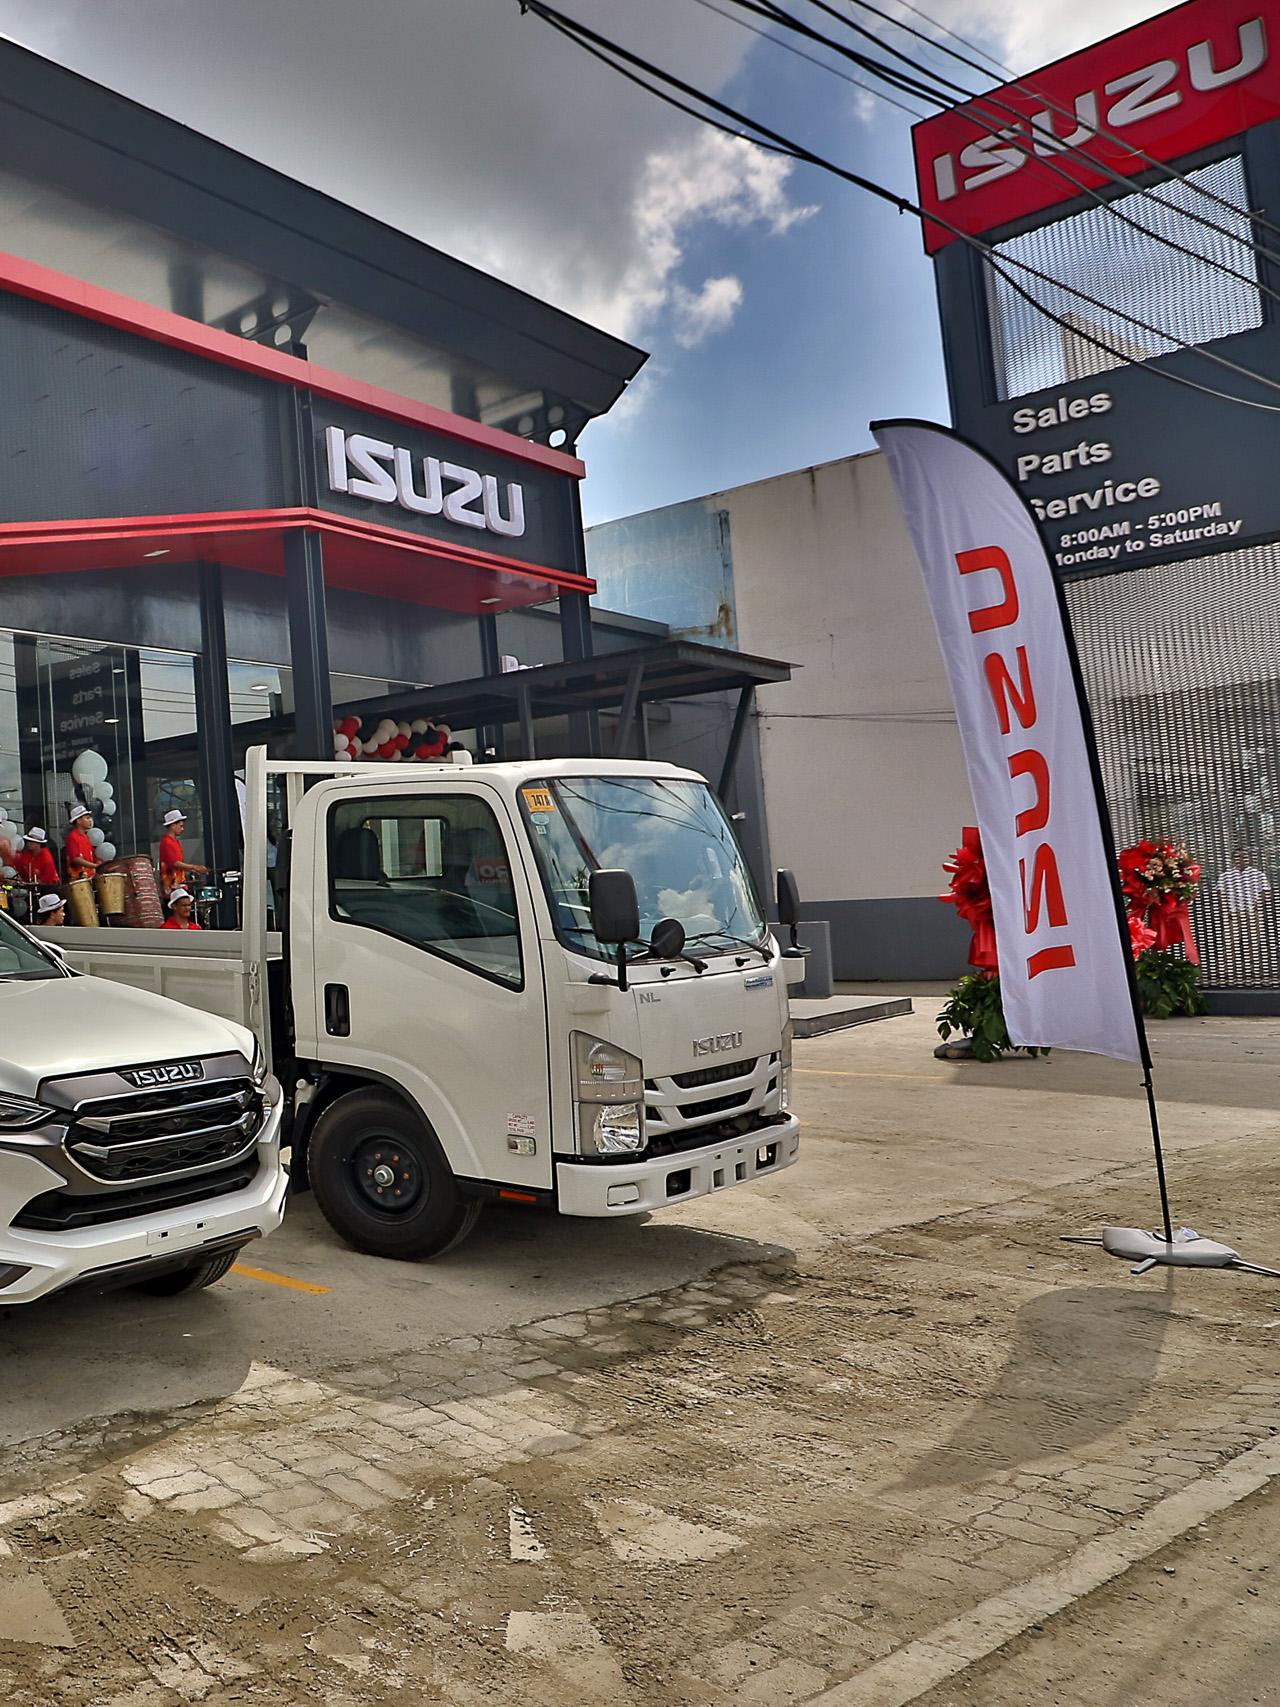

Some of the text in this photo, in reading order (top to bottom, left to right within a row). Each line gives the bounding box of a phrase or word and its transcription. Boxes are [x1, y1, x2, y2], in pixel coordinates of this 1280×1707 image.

[933, 17, 1268, 202] ISUZU
[1012, 391, 1113, 433] Sales
[325, 426, 526, 537] ISUZU
[1017, 440, 1113, 481] Parts
[1060, 521, 1131, 548] 8:00AM
[1147, 502, 1222, 529] 5:00PM
[1125, 538, 1145, 553] to
[1149, 519, 1243, 547] Saturday
[955, 545, 1076, 980] ISUZU
[692, 1030, 743, 1057] ISUZU
[131, 1063, 196, 1086] ISUZU
